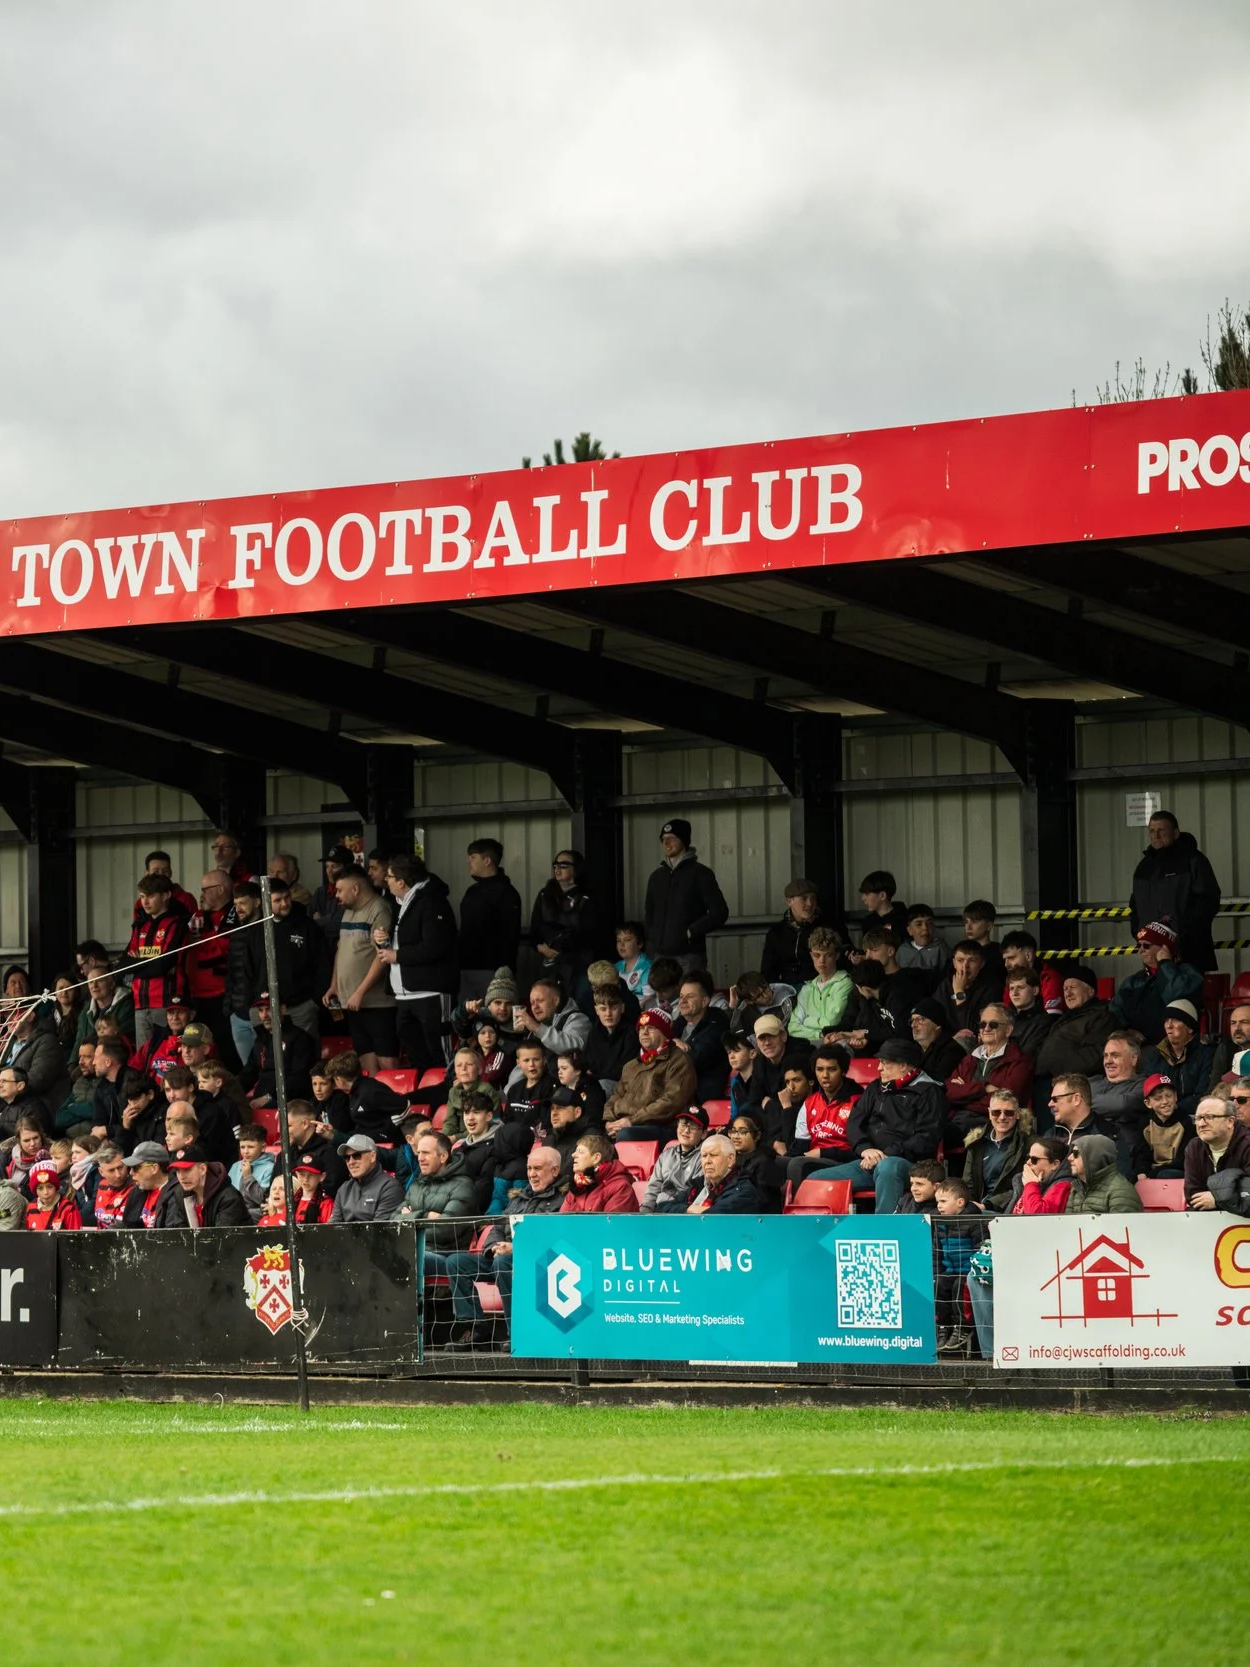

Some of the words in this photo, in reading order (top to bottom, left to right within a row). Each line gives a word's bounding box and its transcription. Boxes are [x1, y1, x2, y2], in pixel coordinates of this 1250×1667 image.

[12, 528, 206, 608] TOWN
[229, 490, 626, 590] FOOTBALL
[650, 463, 863, 552] CLUB
[603, 1248, 753, 1272] BLUEWING
[603, 1279, 681, 1293] DIGITAL
[638, 1314, 654, 1324] SEO
[655, 1314, 661, 1324] &
[662, 1314, 701, 1327] Marketing
[702, 1314, 745, 1326] Specialists
[817, 1335, 923, 1350] www.bluewing.digital
[1029, 1344, 1186, 1361] info@cjwscaffolding.co.uk
